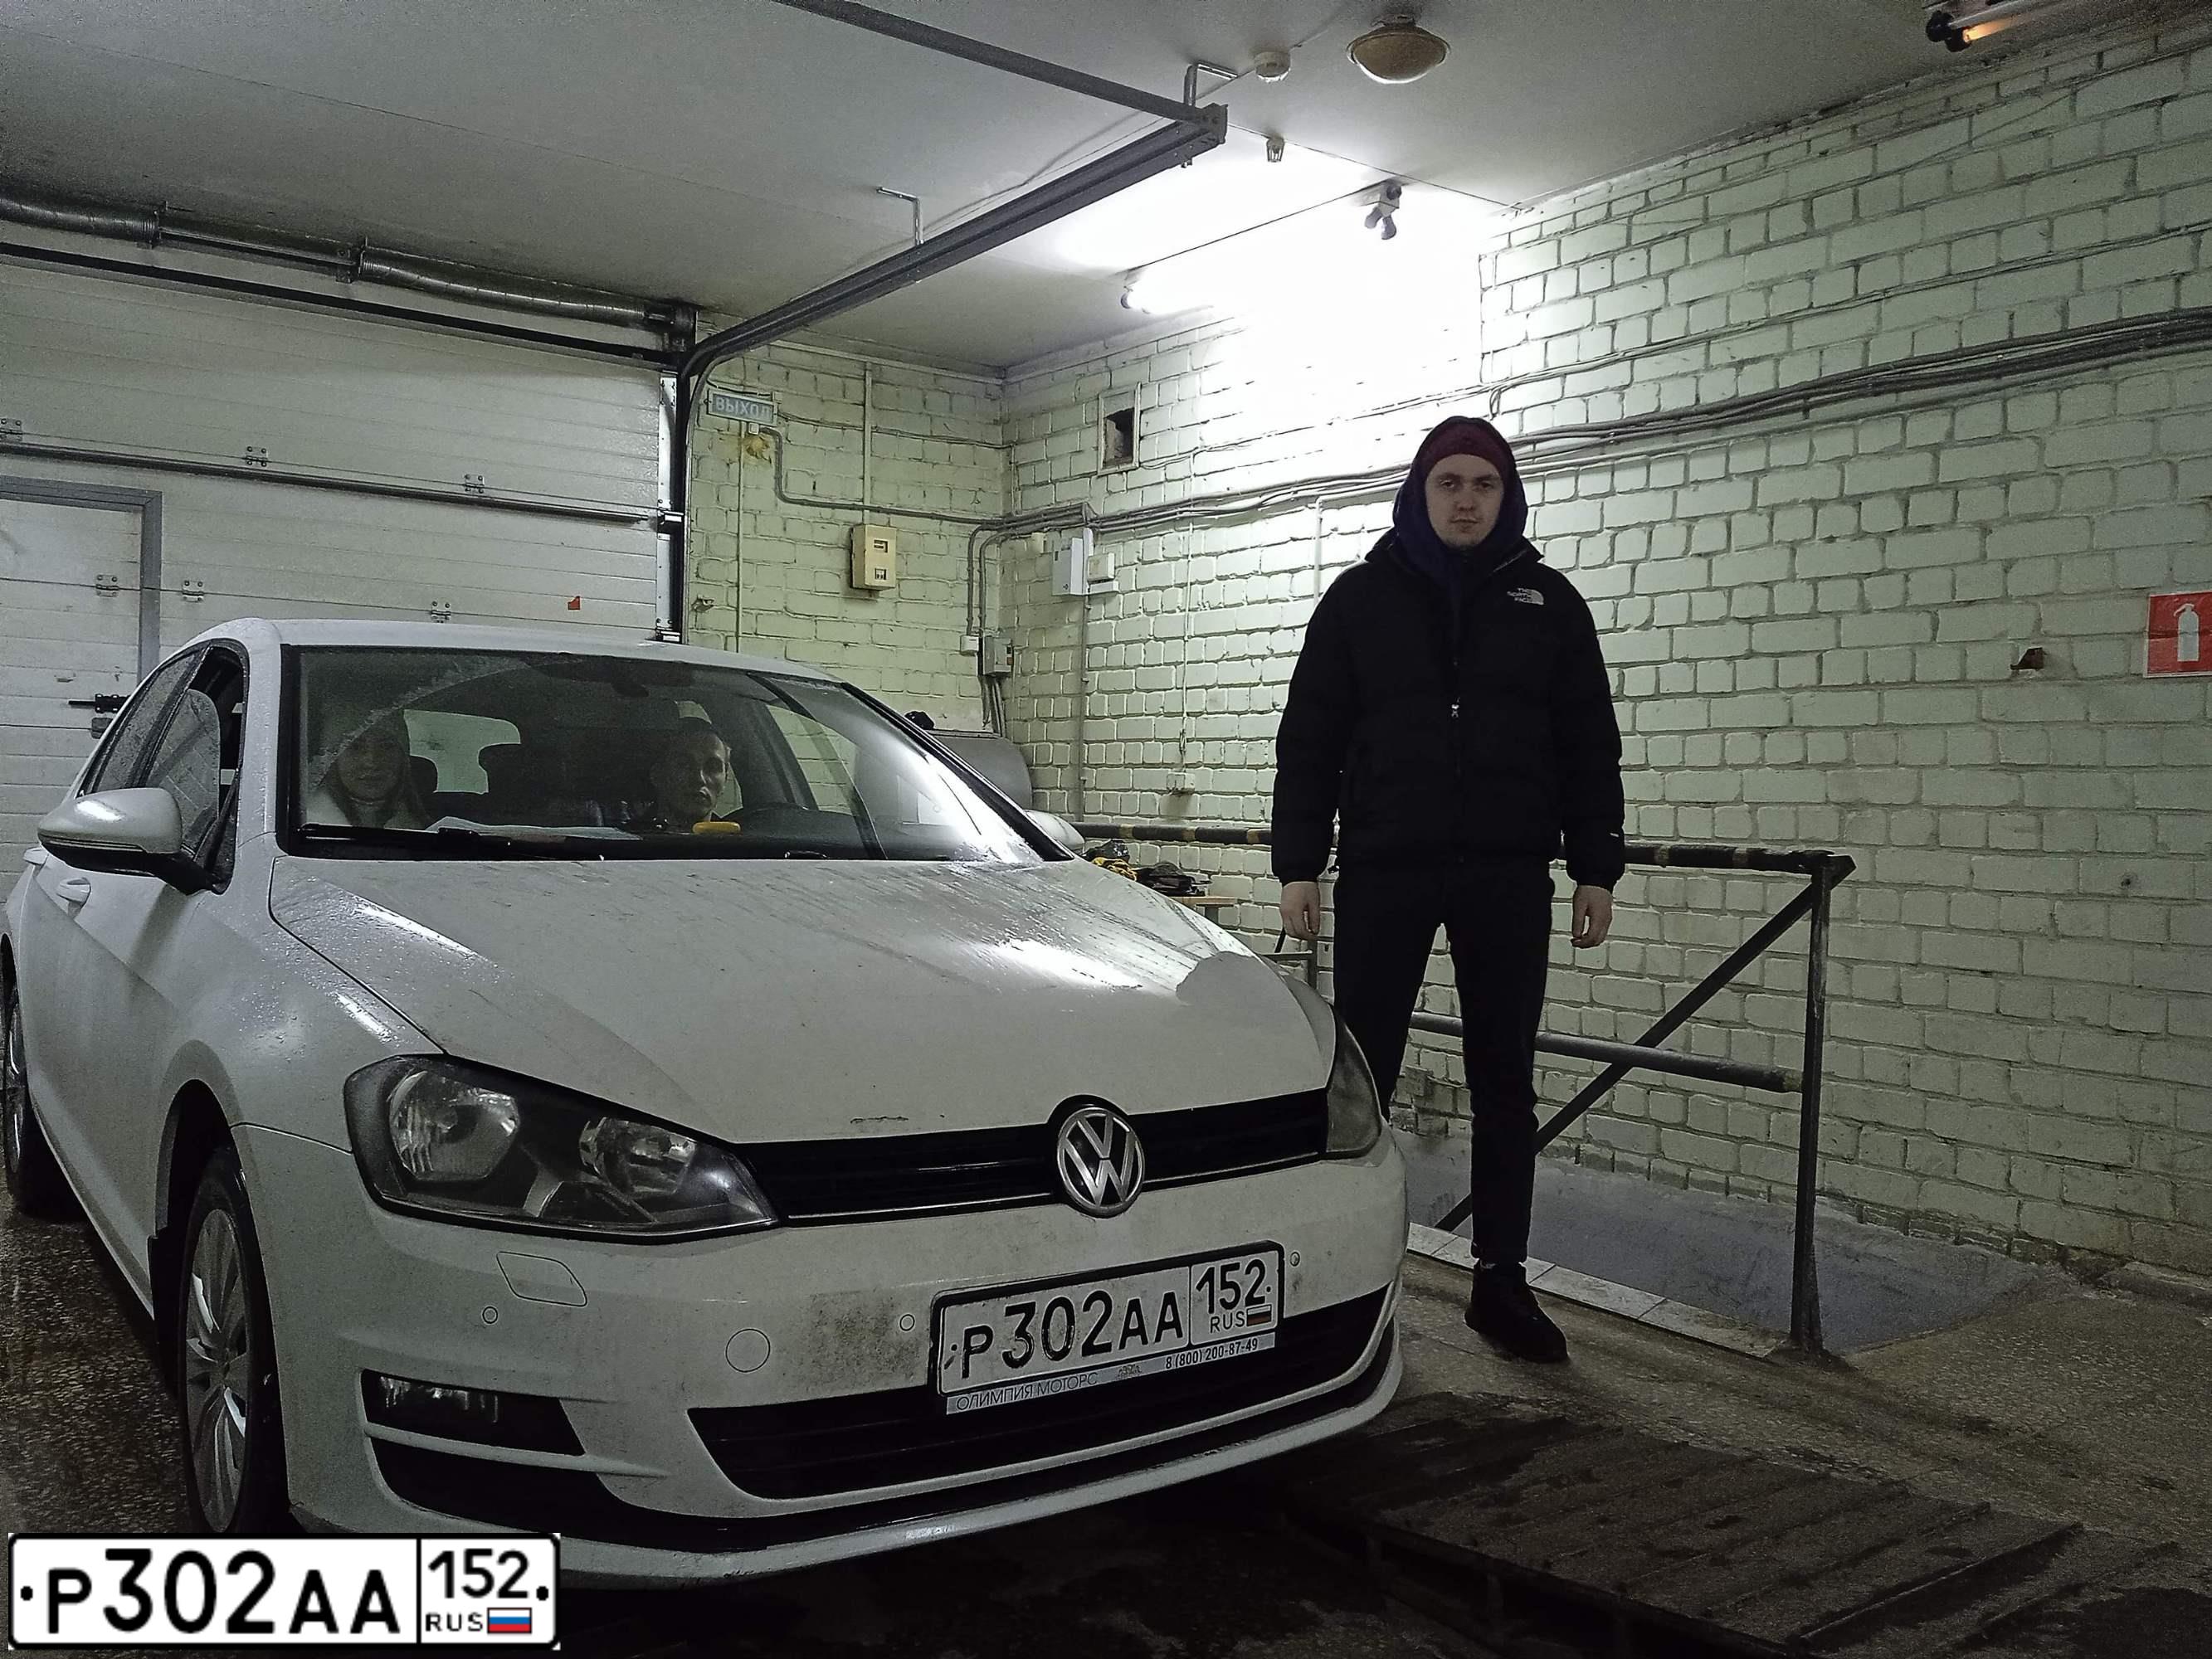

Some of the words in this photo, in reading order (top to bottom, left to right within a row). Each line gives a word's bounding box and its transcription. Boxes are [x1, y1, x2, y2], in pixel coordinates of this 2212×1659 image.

[1196, 1259, 1266, 1314] 152
[1211, 1312, 1245, 1333] RUS
[1166, 1356, 1172, 1370] 8
[1175, 1350, 1202, 1368] (800)
[1206, 1338, 1258, 1360] 200-87-49
[957, 1384, 1033, 1410] ОЛИМПИЯ
[1037, 1371, 1099, 1395] МОТОРС
